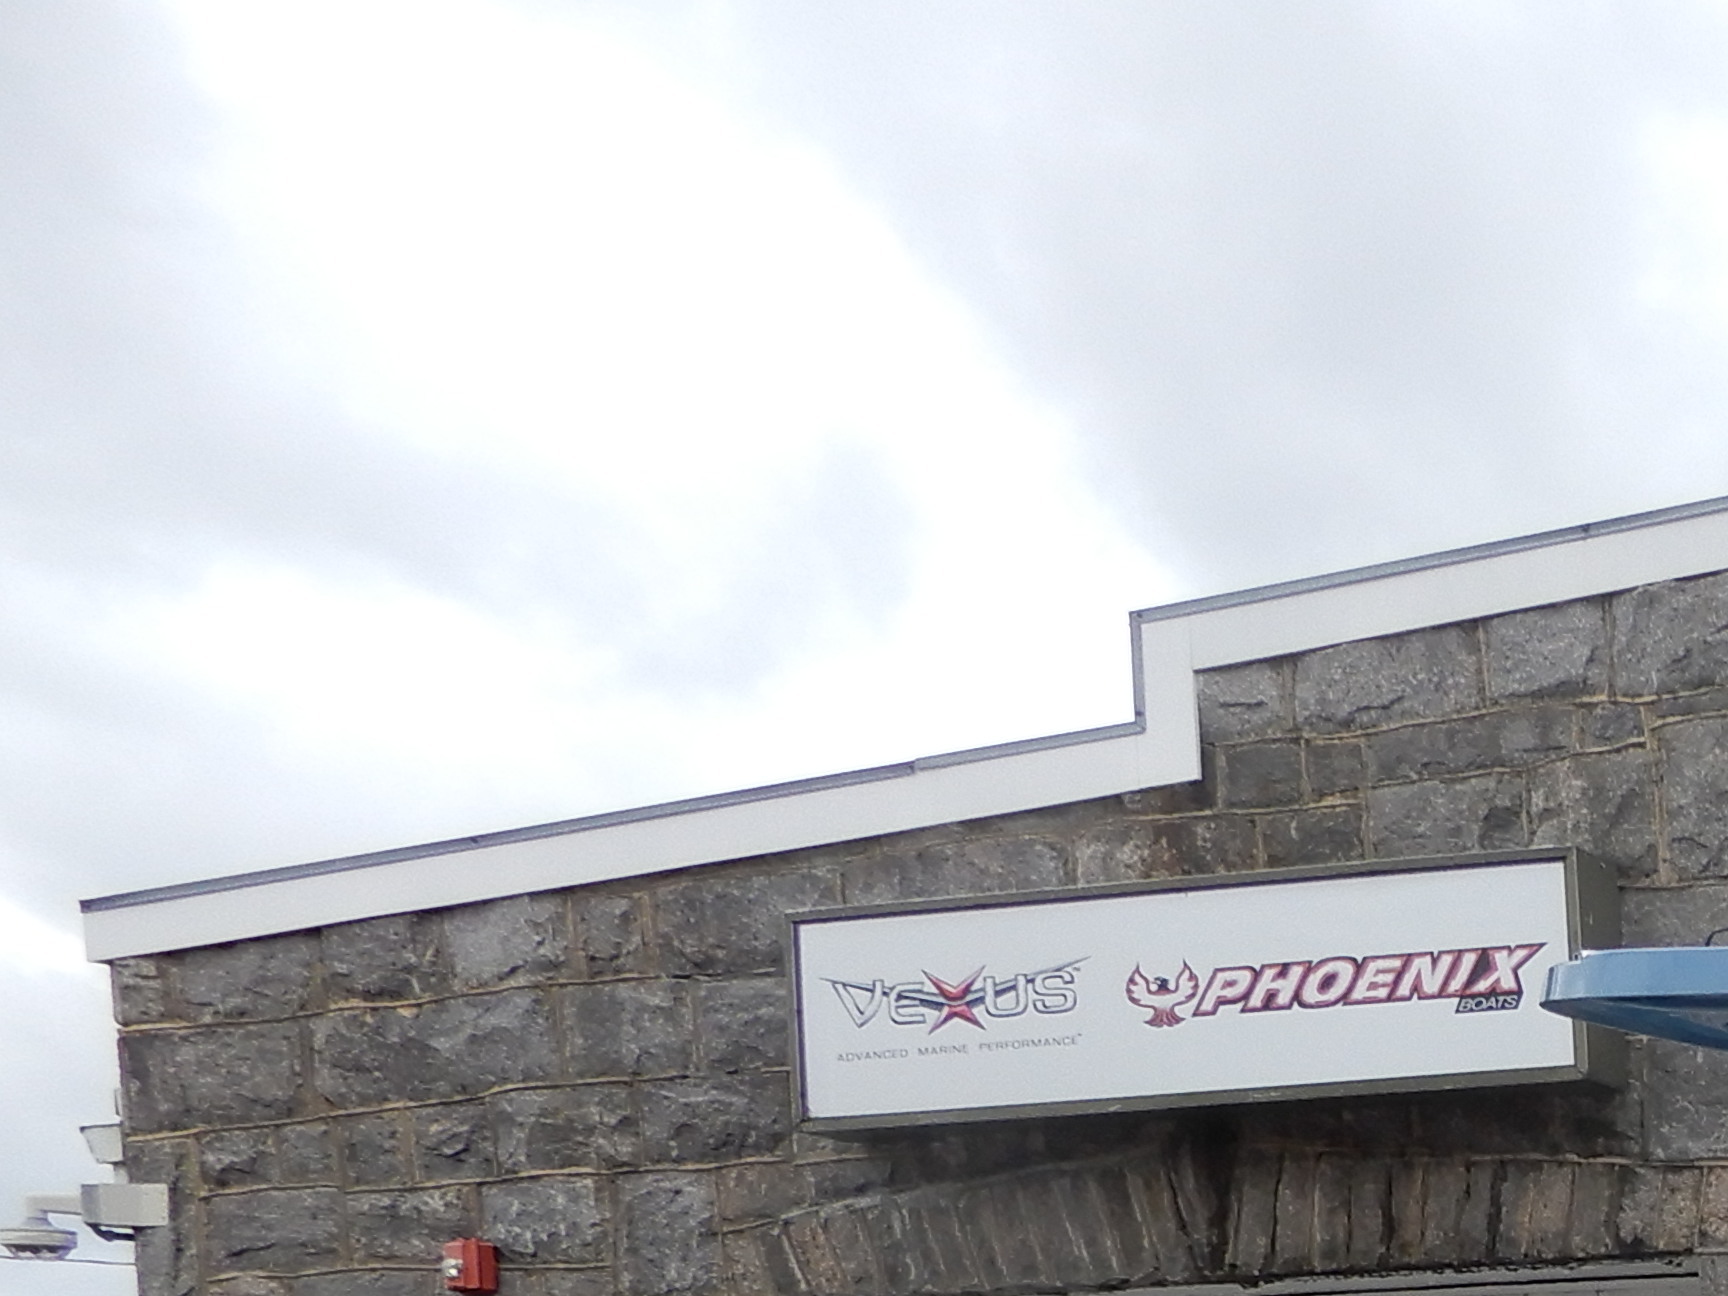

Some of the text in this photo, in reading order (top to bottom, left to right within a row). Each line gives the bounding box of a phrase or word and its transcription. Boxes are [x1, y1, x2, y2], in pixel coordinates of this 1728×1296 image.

[829, 964, 1079, 1036] VEXUS
[1192, 942, 1548, 1018] PHOENIX
[1457, 995, 1518, 1013] BOATS
[836, 1034, 1078, 1063] ADVANCED MARINE PERFORMANCE
